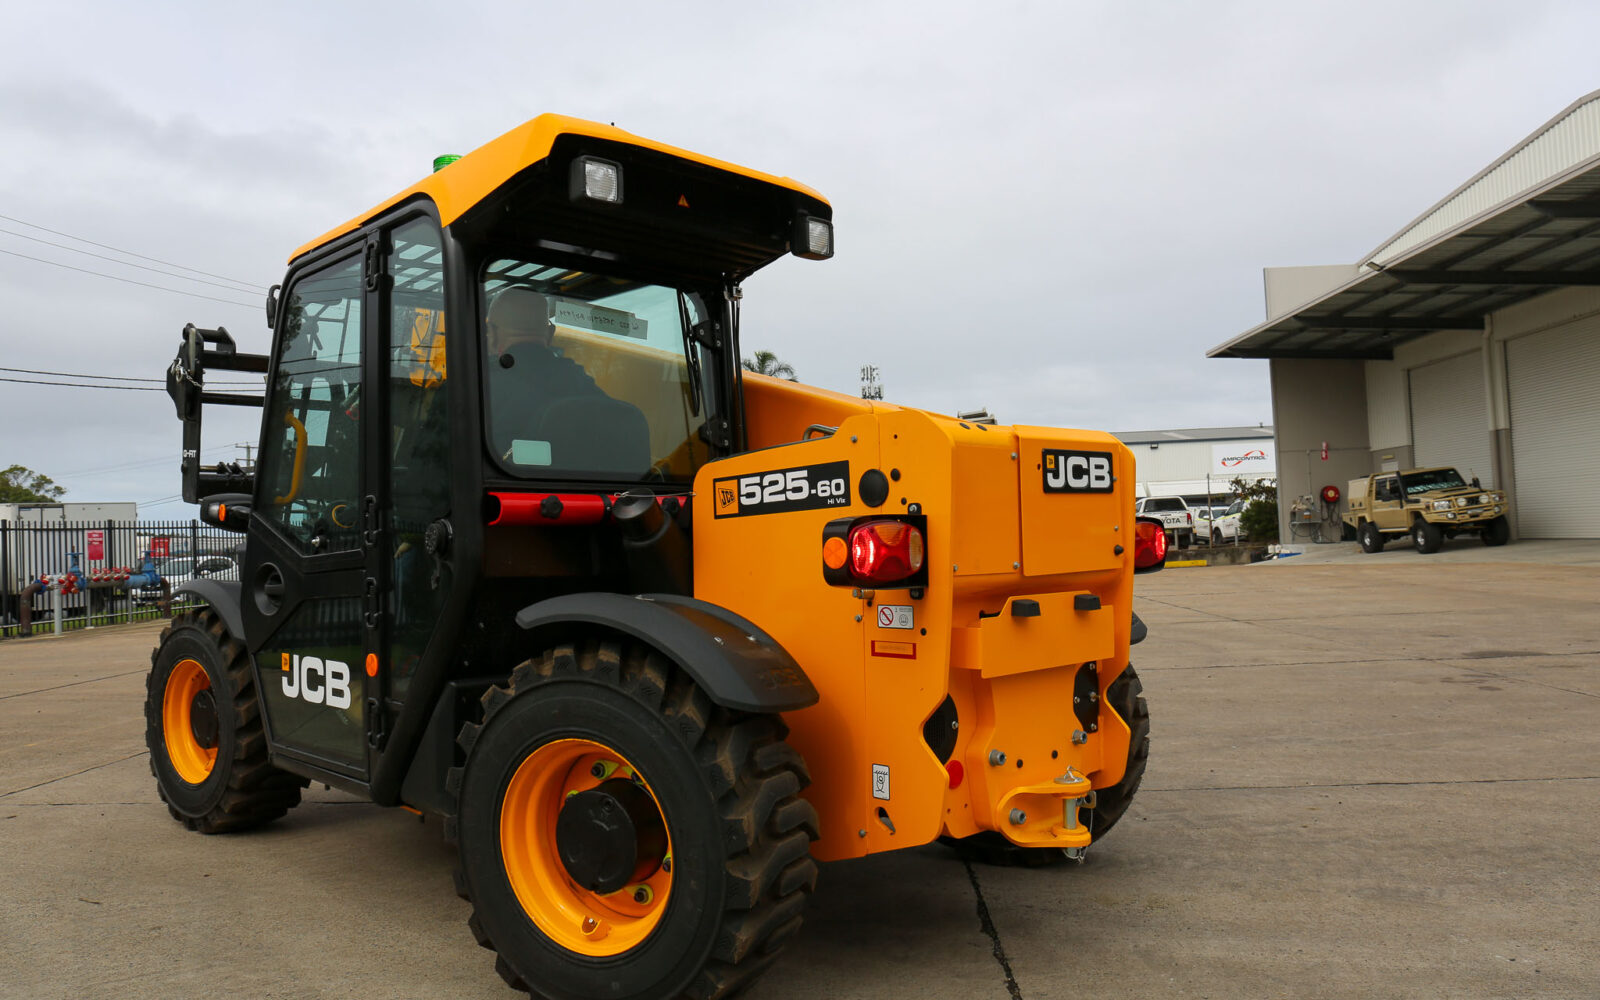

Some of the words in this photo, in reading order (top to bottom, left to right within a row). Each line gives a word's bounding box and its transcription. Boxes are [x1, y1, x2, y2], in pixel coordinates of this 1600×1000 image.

[740, 469, 845, 506] 525-60
[1047, 455, 1111, 488] JCB
[1161, 516, 1182, 524] YOTA
[282, 654, 351, 710] JCB
